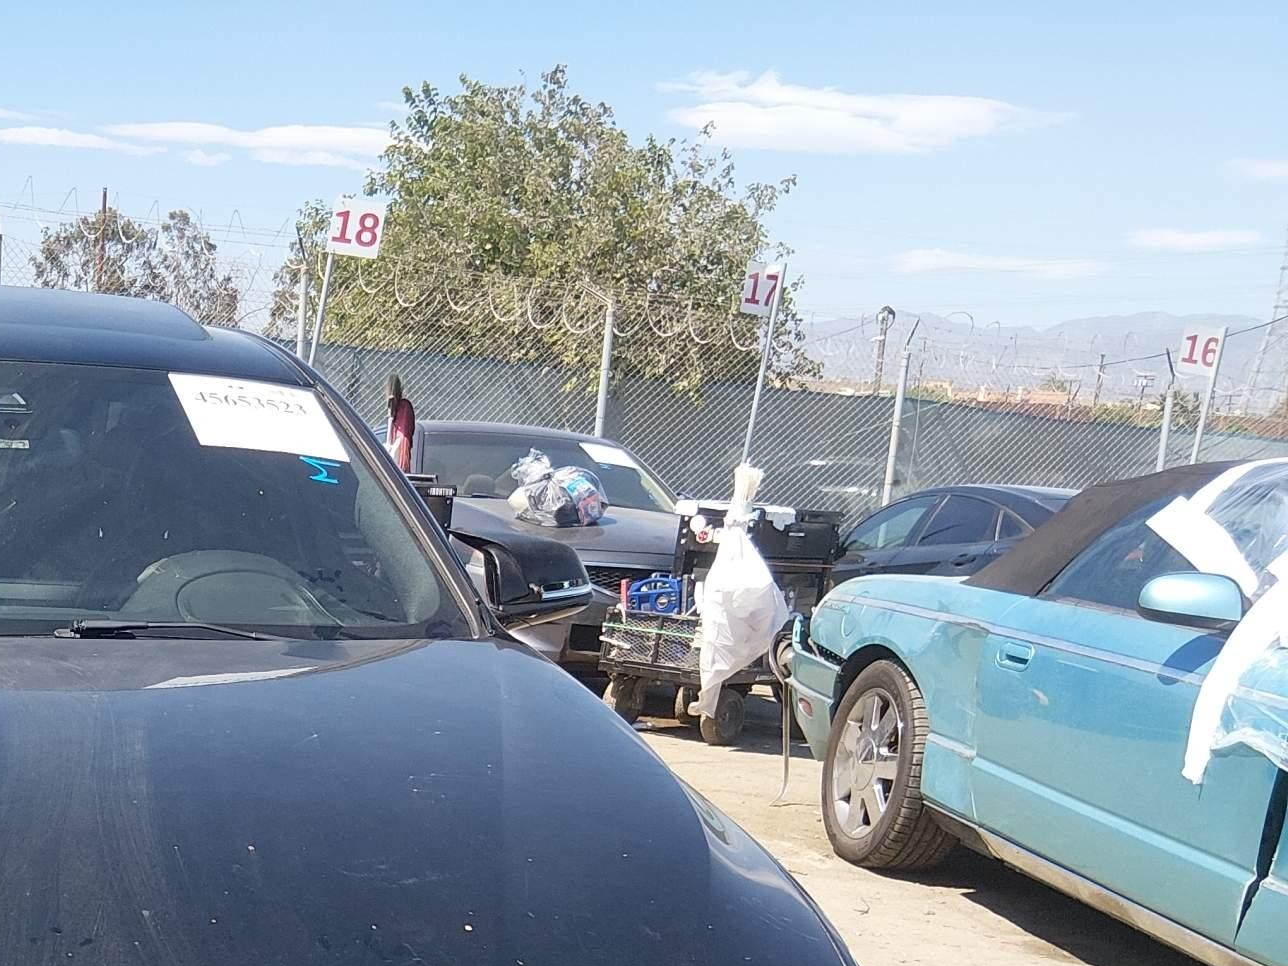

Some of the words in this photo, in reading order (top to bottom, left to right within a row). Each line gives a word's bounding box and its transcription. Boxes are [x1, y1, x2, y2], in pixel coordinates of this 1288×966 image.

[331, 210, 379, 247] 18
[744, 271, 779, 307] 17
[1181, 334, 1219, 368] 16
